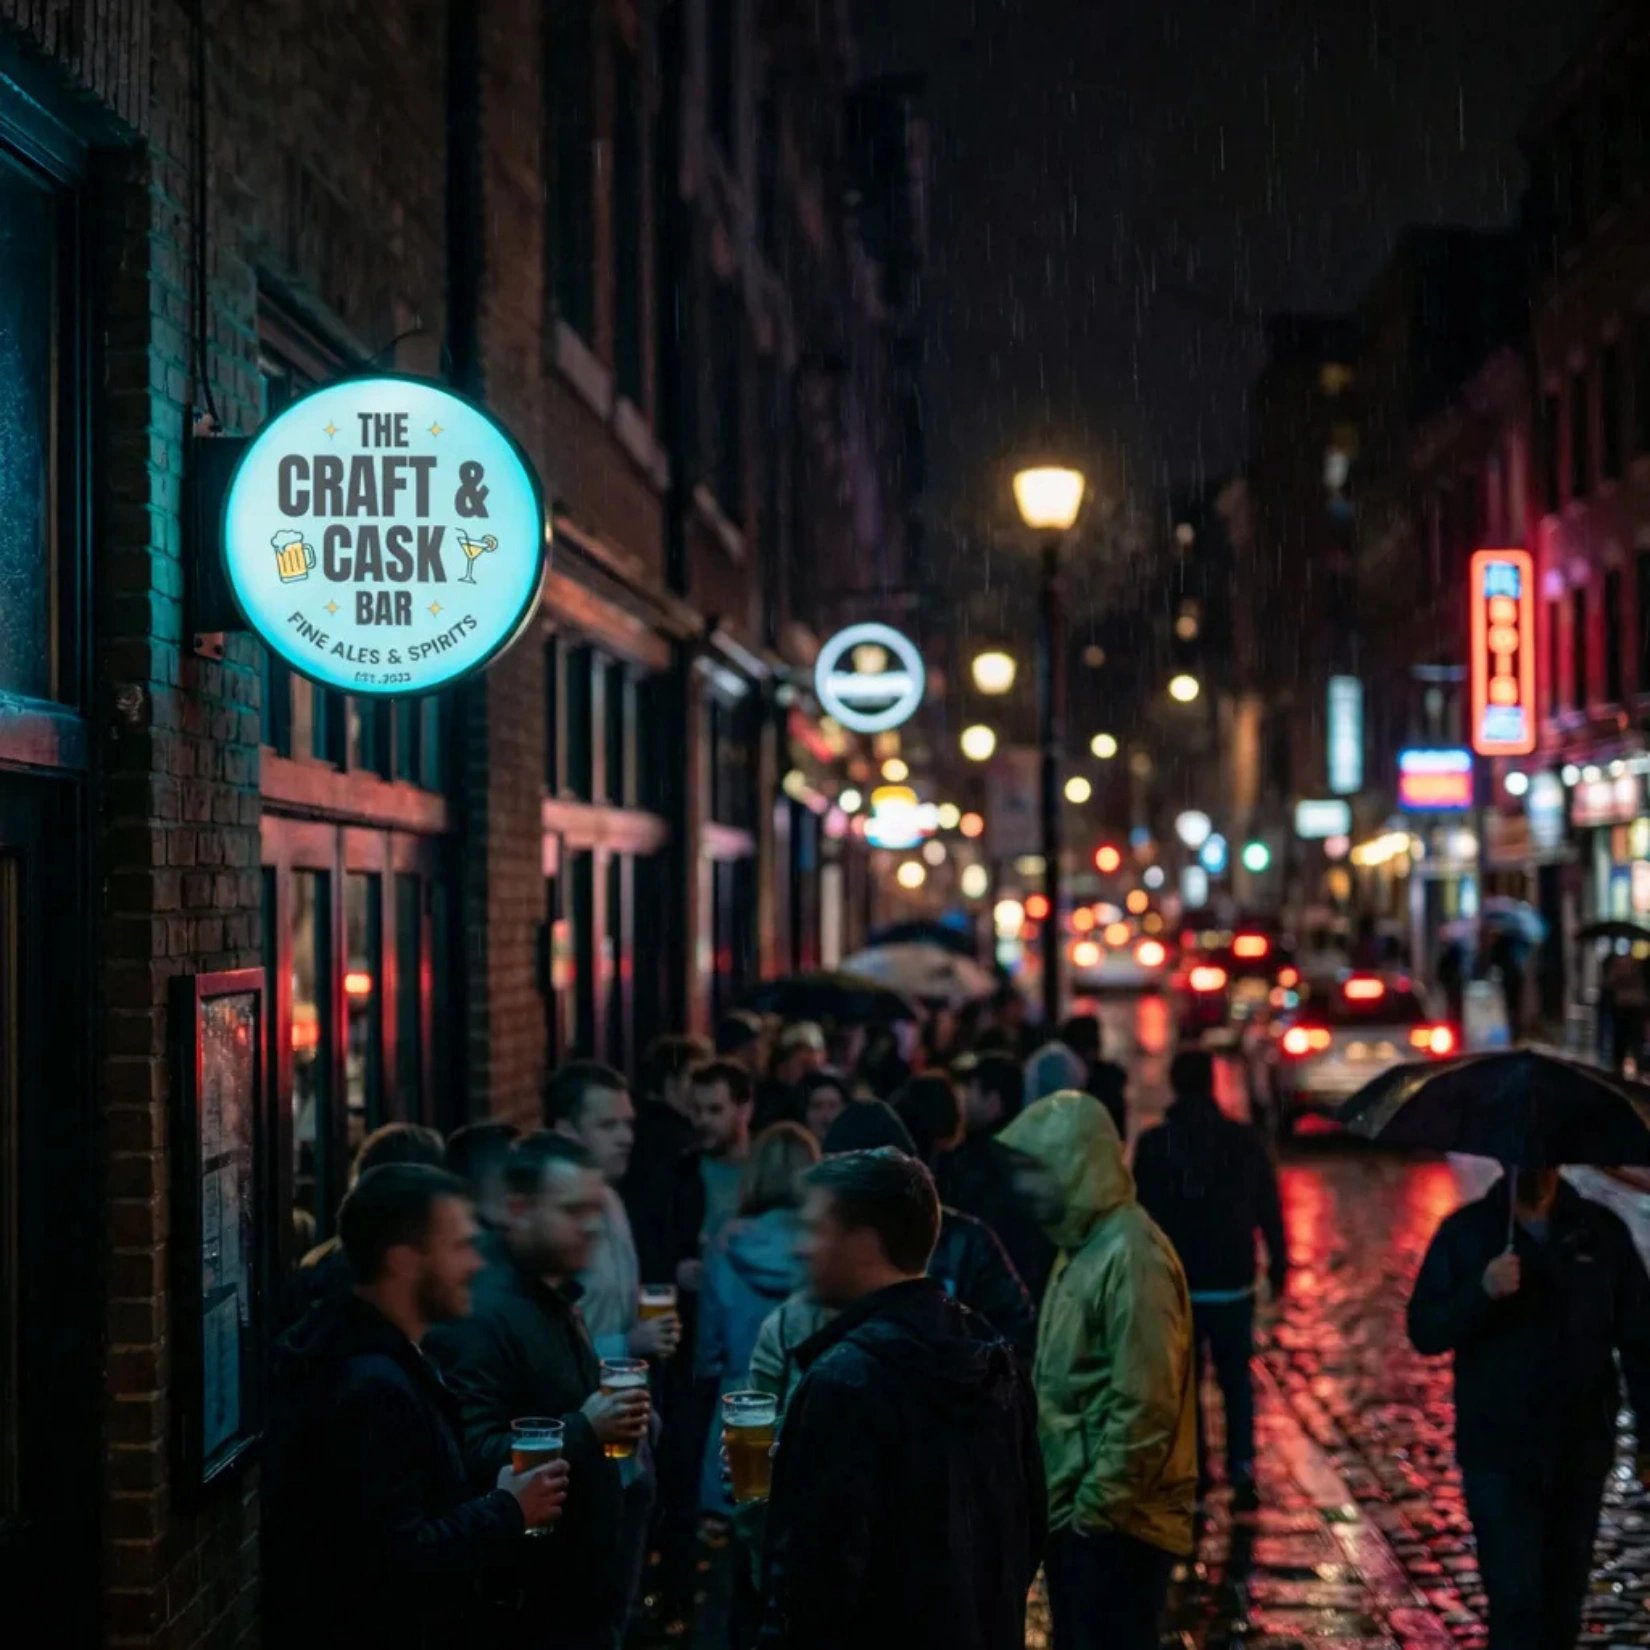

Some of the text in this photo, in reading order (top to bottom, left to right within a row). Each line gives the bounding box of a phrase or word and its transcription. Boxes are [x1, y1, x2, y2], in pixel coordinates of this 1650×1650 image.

[357, 412, 409, 449] THE
[278, 454, 489, 518] CRAFT &
[323, 524, 447, 583] CASK
[355, 591, 412, 626] BAR
[287, 611, 477, 664] FINE ALES & SPIRITS
